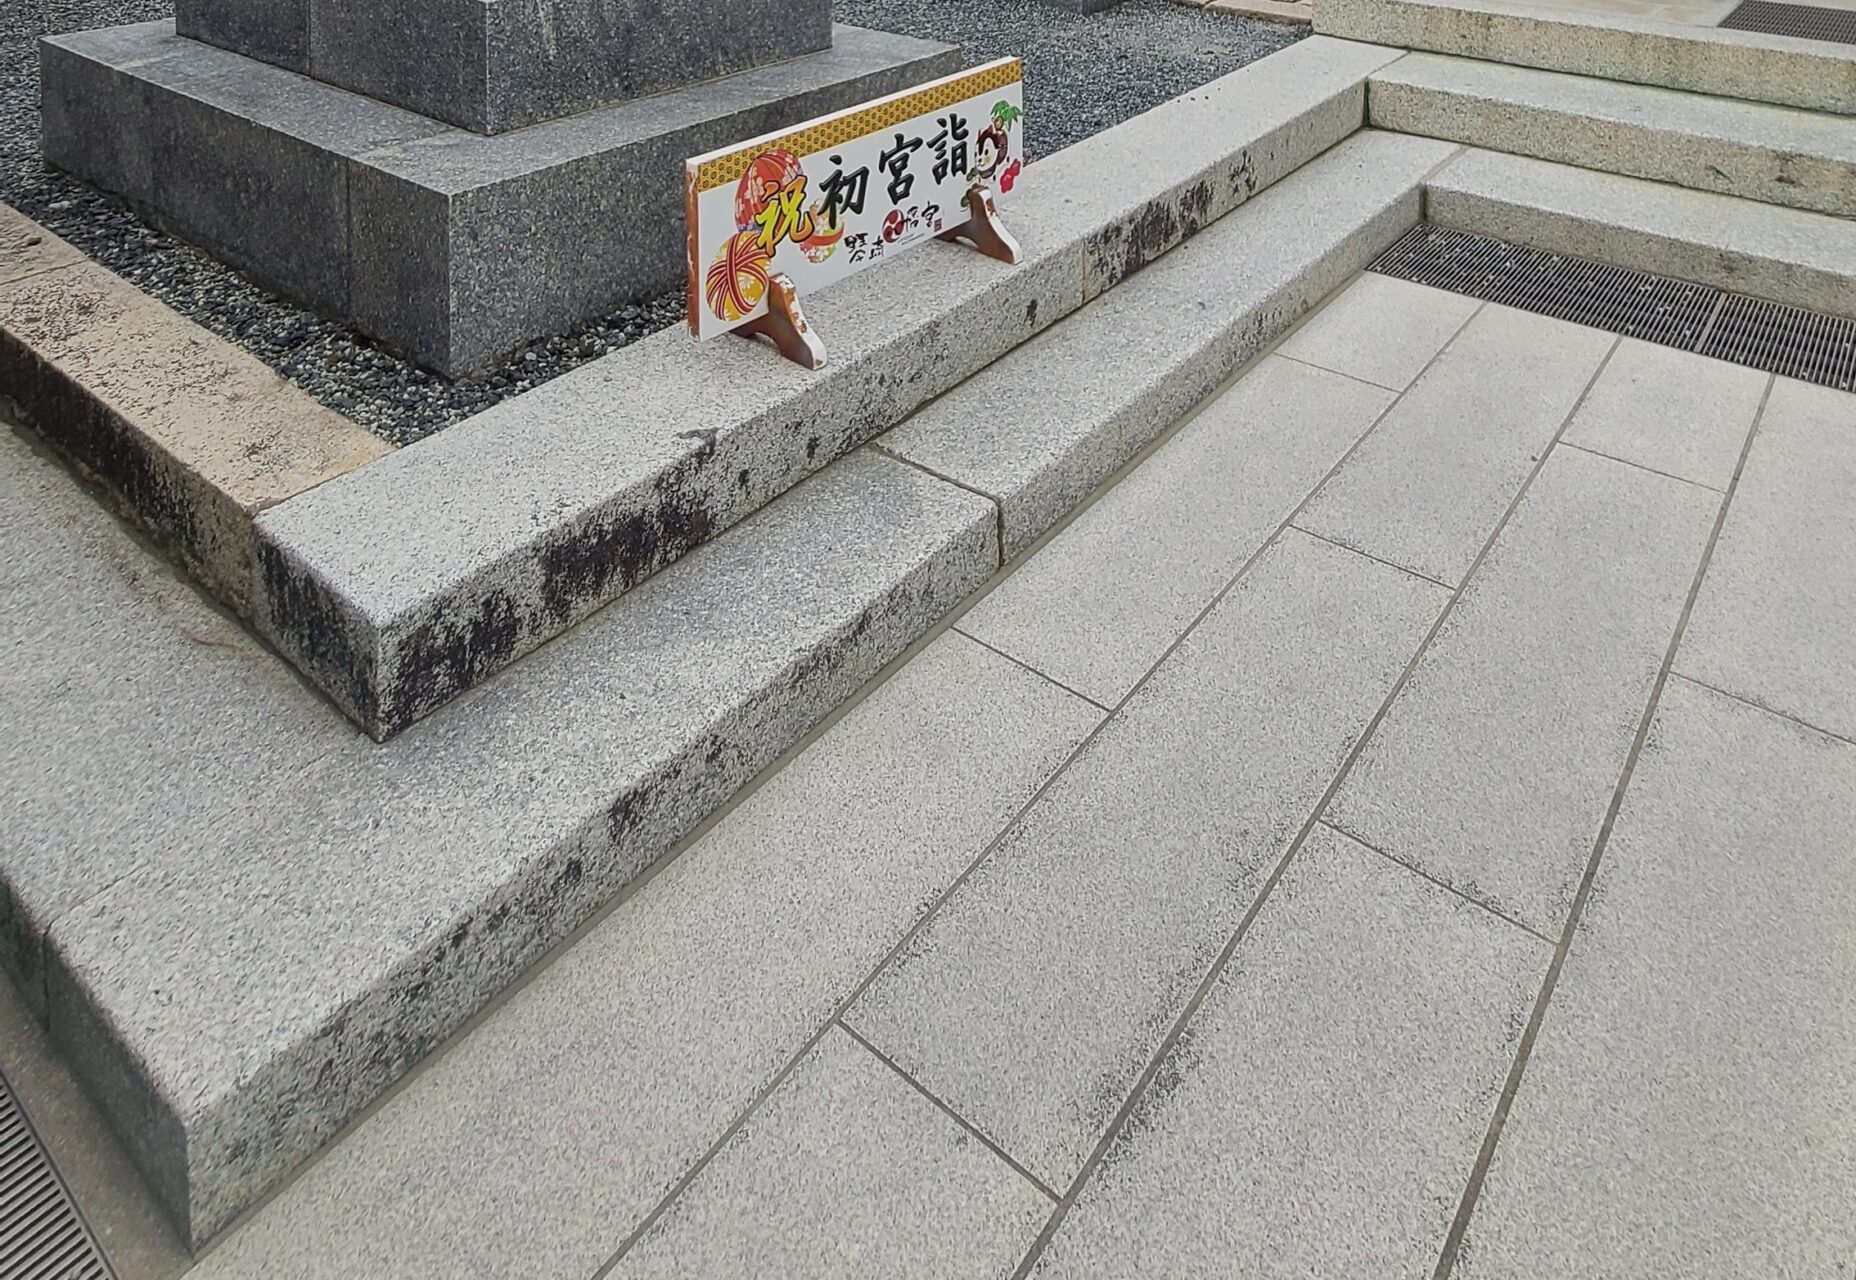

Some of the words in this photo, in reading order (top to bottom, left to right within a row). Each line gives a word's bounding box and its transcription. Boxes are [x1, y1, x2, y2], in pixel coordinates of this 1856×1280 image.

[755, 175, 815, 257] 祝
[818, 113, 969, 229] 初宮詣
